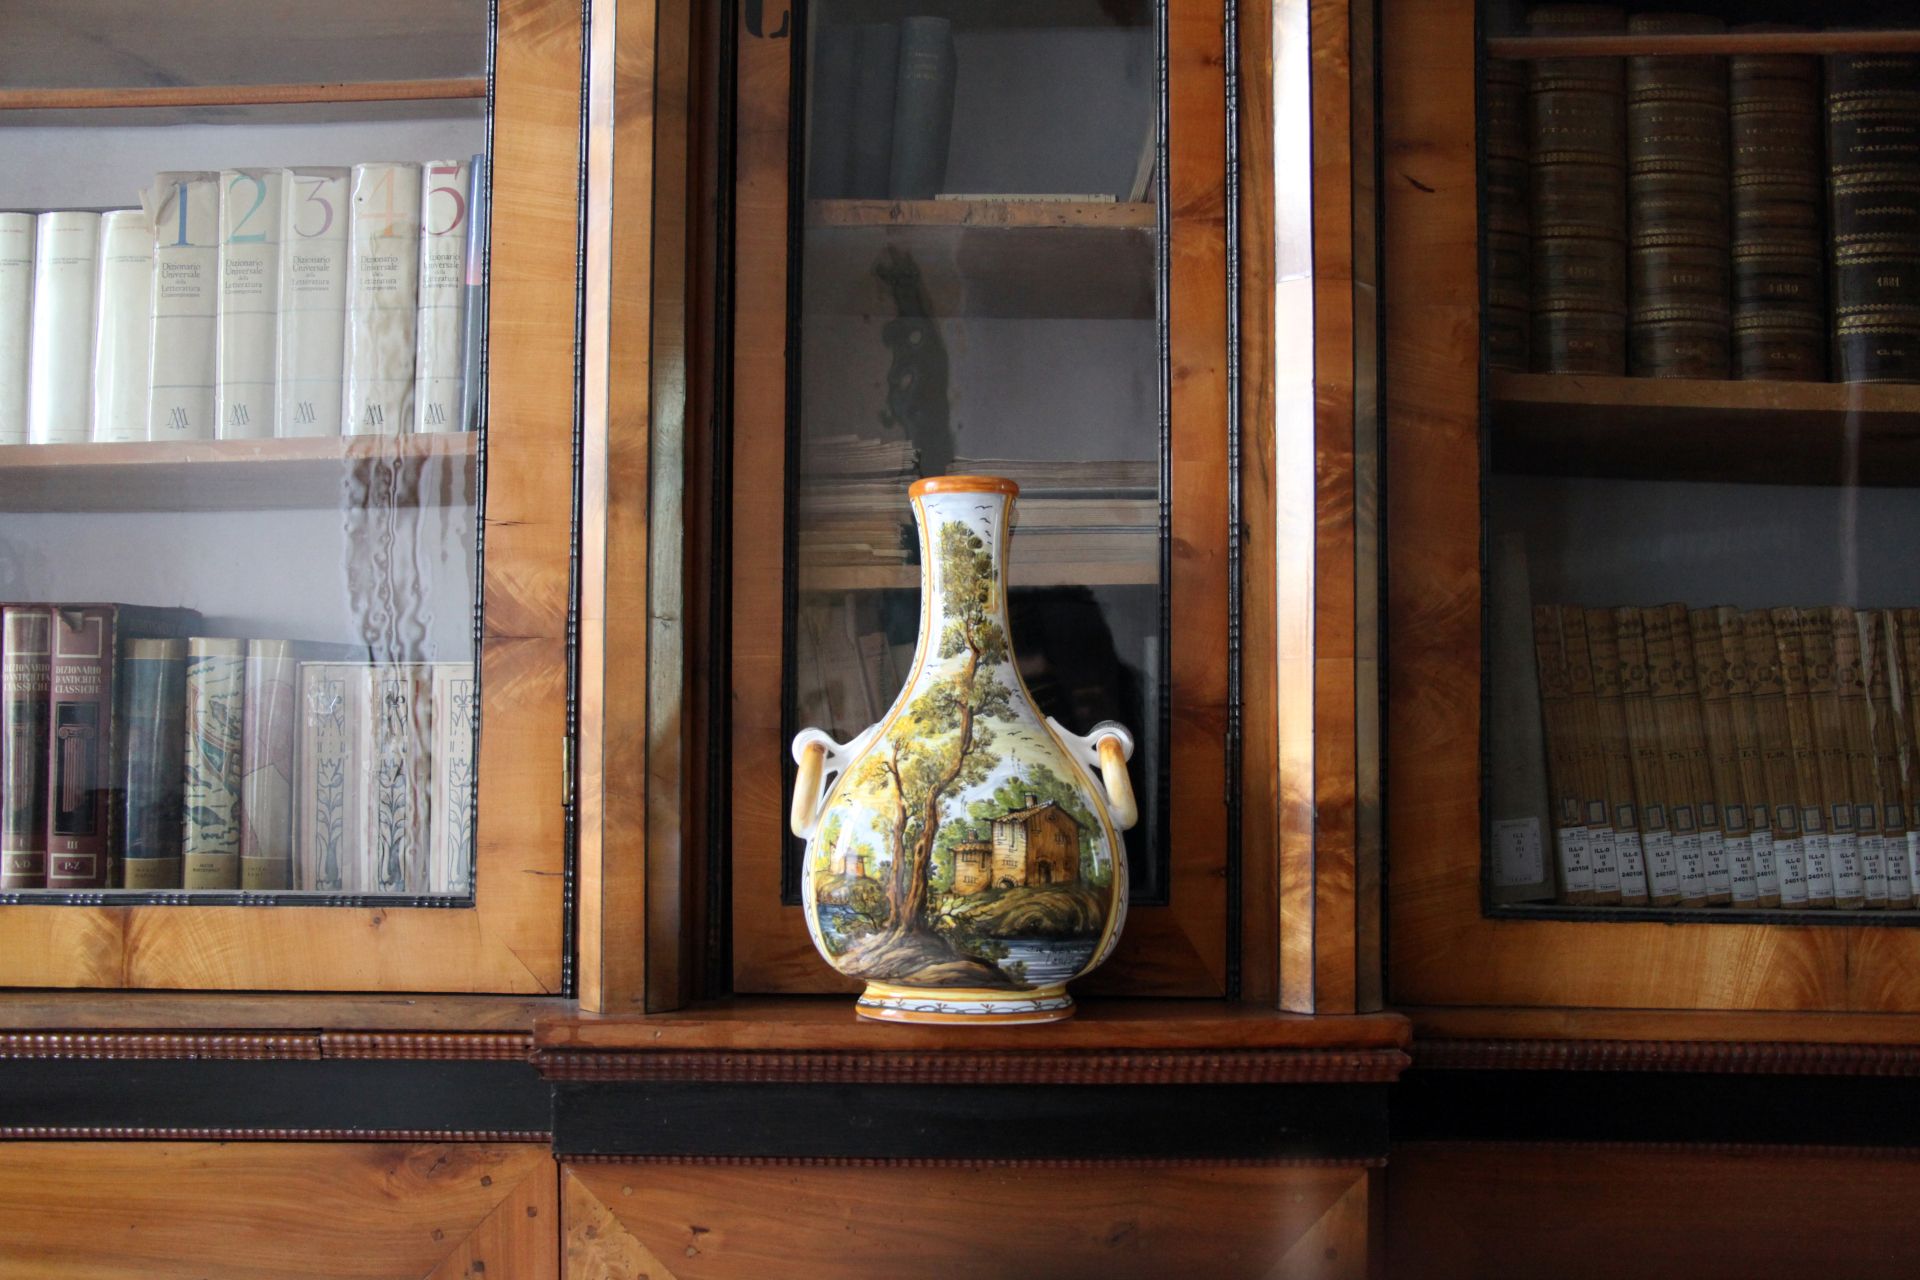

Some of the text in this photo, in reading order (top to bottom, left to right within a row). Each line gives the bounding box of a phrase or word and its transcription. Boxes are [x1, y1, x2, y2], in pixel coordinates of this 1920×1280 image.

[359, 167, 408, 239] 4
[423, 166, 466, 237] 5
[225, 173, 268, 245] 2
[293, 178, 334, 238] 3
[171, 181, 195, 247] 1
[225, 258, 264, 267] Dizionario
[292, 255, 330, 263] Dizionario
[162, 263, 201, 271] Dizionario
[225, 266, 264, 276] Universale
[292, 263, 330, 272] Universale
[360, 263, 398, 271] Universale
[162, 270, 201, 279] Universale
[161, 284, 201, 292] Letteratura
[225, 281, 263, 289] Letteratura
[55, 665, 102, 675] DIZIONARIO
[55, 684, 101, 694] CLASSICHE
[67, 840, 79, 849] III
